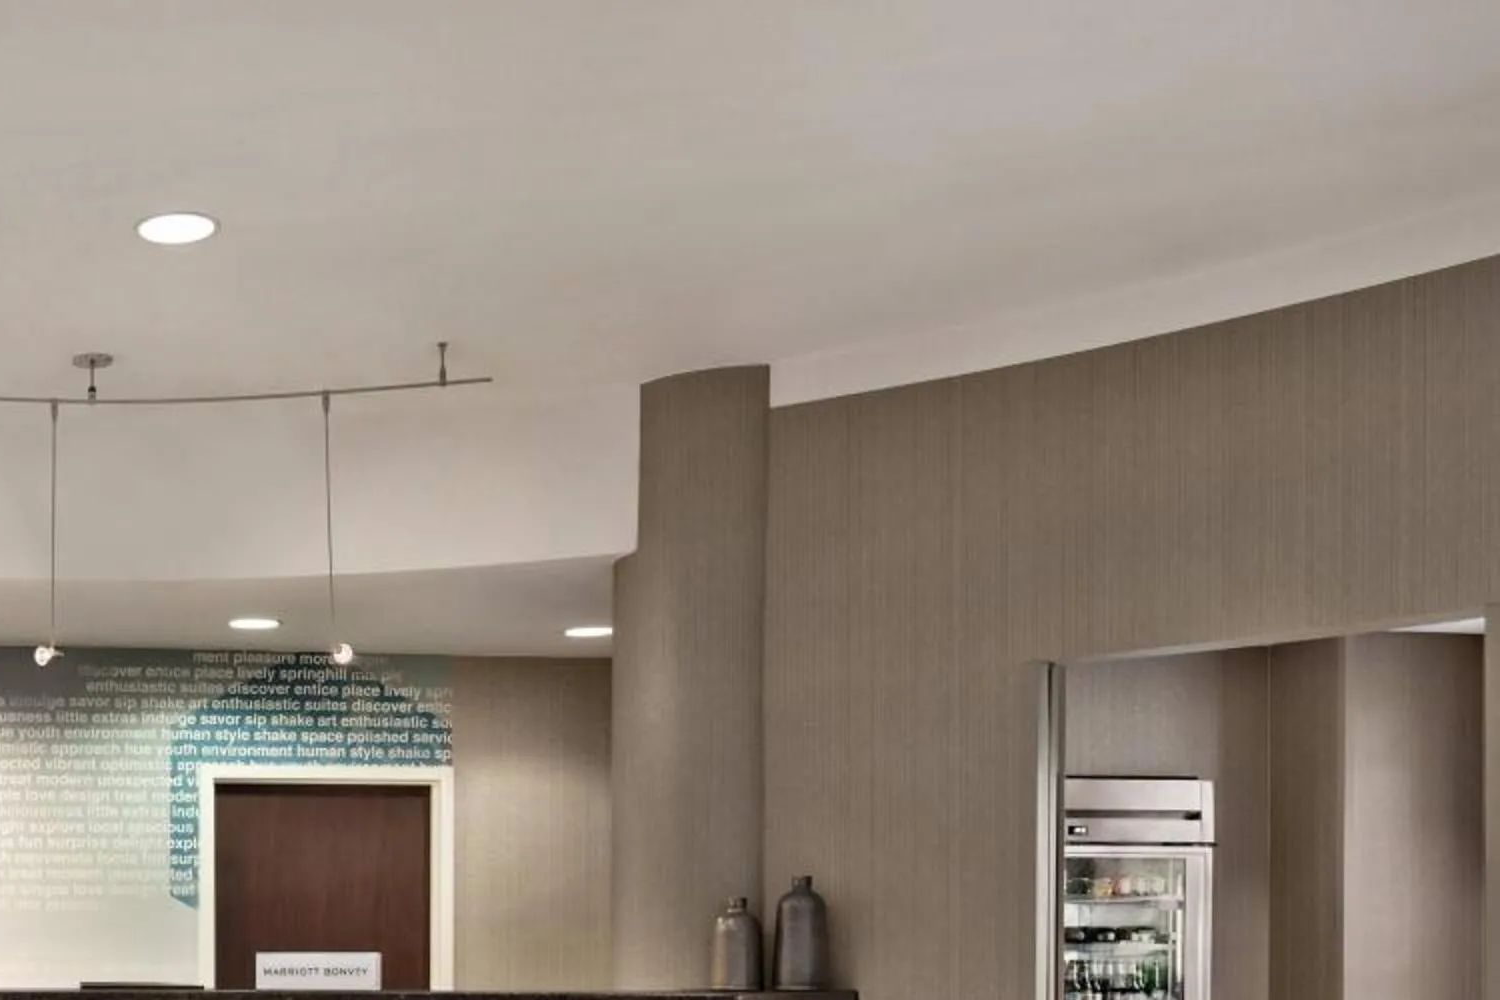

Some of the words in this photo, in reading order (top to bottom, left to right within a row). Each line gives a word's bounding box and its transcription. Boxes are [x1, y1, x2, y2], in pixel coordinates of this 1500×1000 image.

[238, 665, 274, 682] lively
[280, 666, 346, 683] springhill
[86, 679, 176, 693] enthusiastic
[228, 680, 290, 695] discover
[294, 682, 338, 696] entice
[342, 683, 380, 699] place
[384, 683, 420, 700] lively
[212, 695, 300, 710] enthusiastic
[304, 697, 347, 711] suites
[352, 698, 412, 712] discover
[57, 708, 87, 722] little
[200, 713, 240, 725] savor
[245, 712, 264, 729] sip
[271, 712, 313, 726] shake
[318, 714, 336, 727] art
[341, 714, 428, 728] enthusiastic
[19, 723, 60, 740] youth
[65, 724, 157, 738] environment
[162, 725, 210, 740] human
[216, 726, 250, 743] style
[254, 727, 296, 741] shake
[301, 730, 343, 744] space
[348, 728, 408, 745] polished
[202, 742, 292, 757] environment
[297, 743, 346, 757] human
[350, 744, 384, 761] style
[388, 744, 430, 758] shake
[263, 967, 319, 977] MARRIOTT
